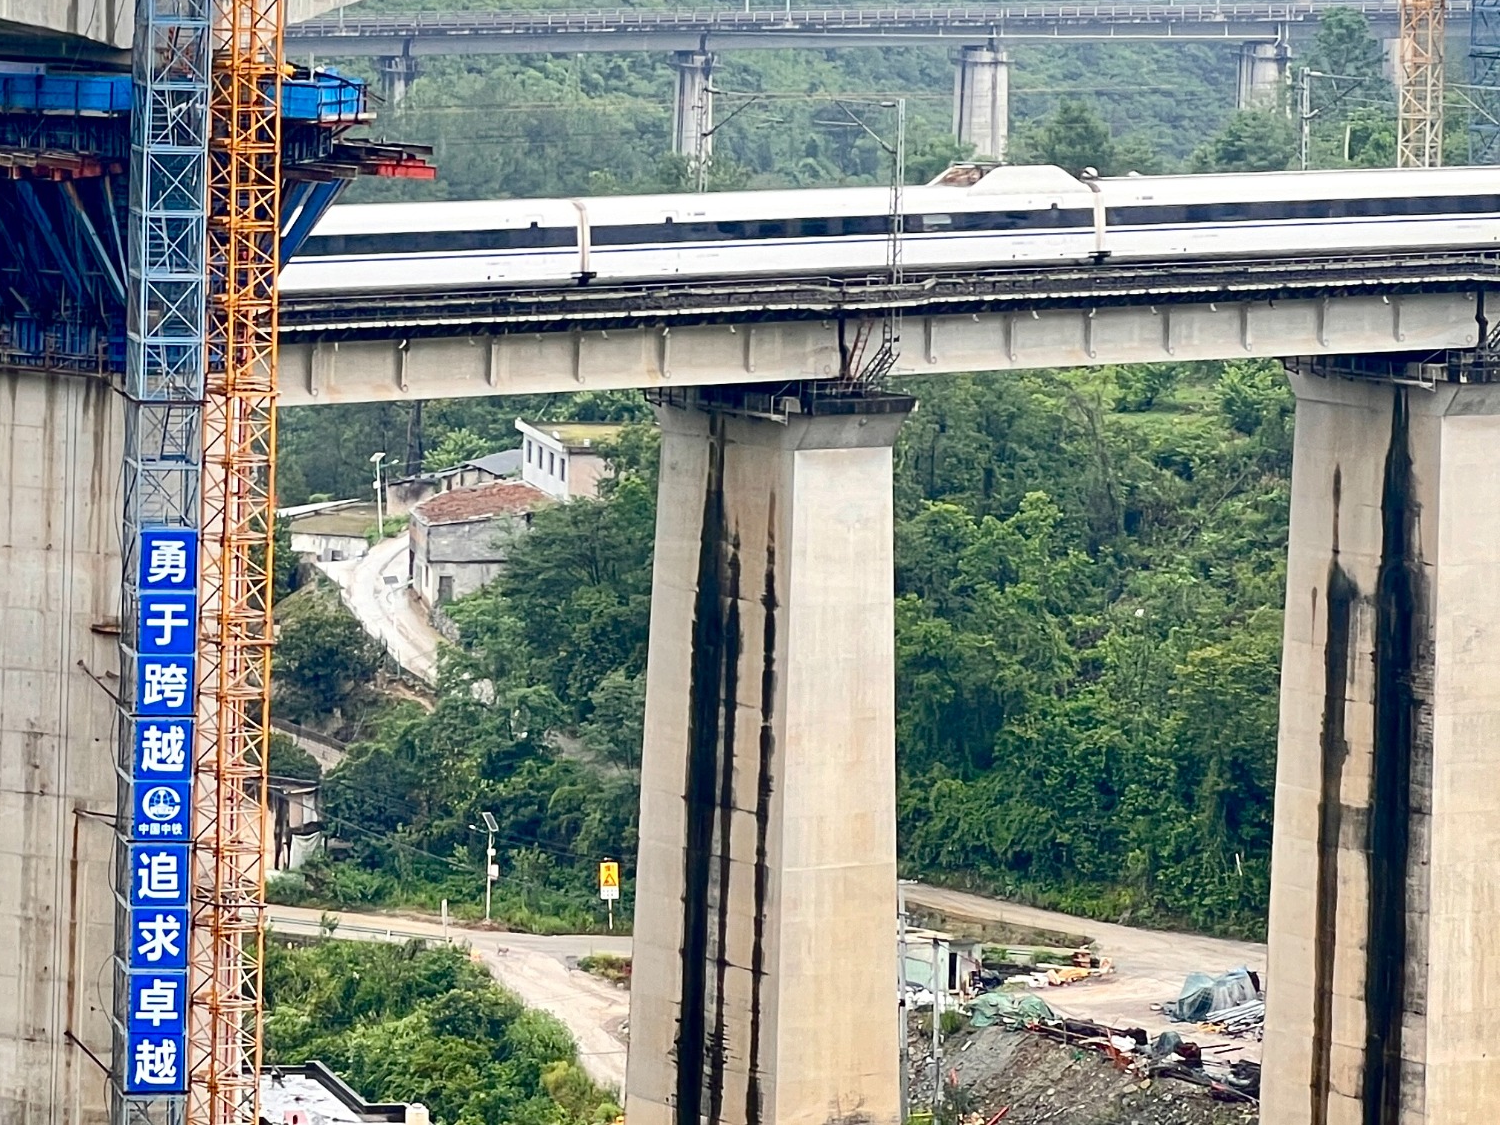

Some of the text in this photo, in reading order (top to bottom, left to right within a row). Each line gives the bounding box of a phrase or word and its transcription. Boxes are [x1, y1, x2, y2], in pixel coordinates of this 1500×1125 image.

[141, 538, 189, 772] 勇于跨越
[138, 822, 183, 836] 中国中铁
[133, 850, 181, 1086] 追求卓越
